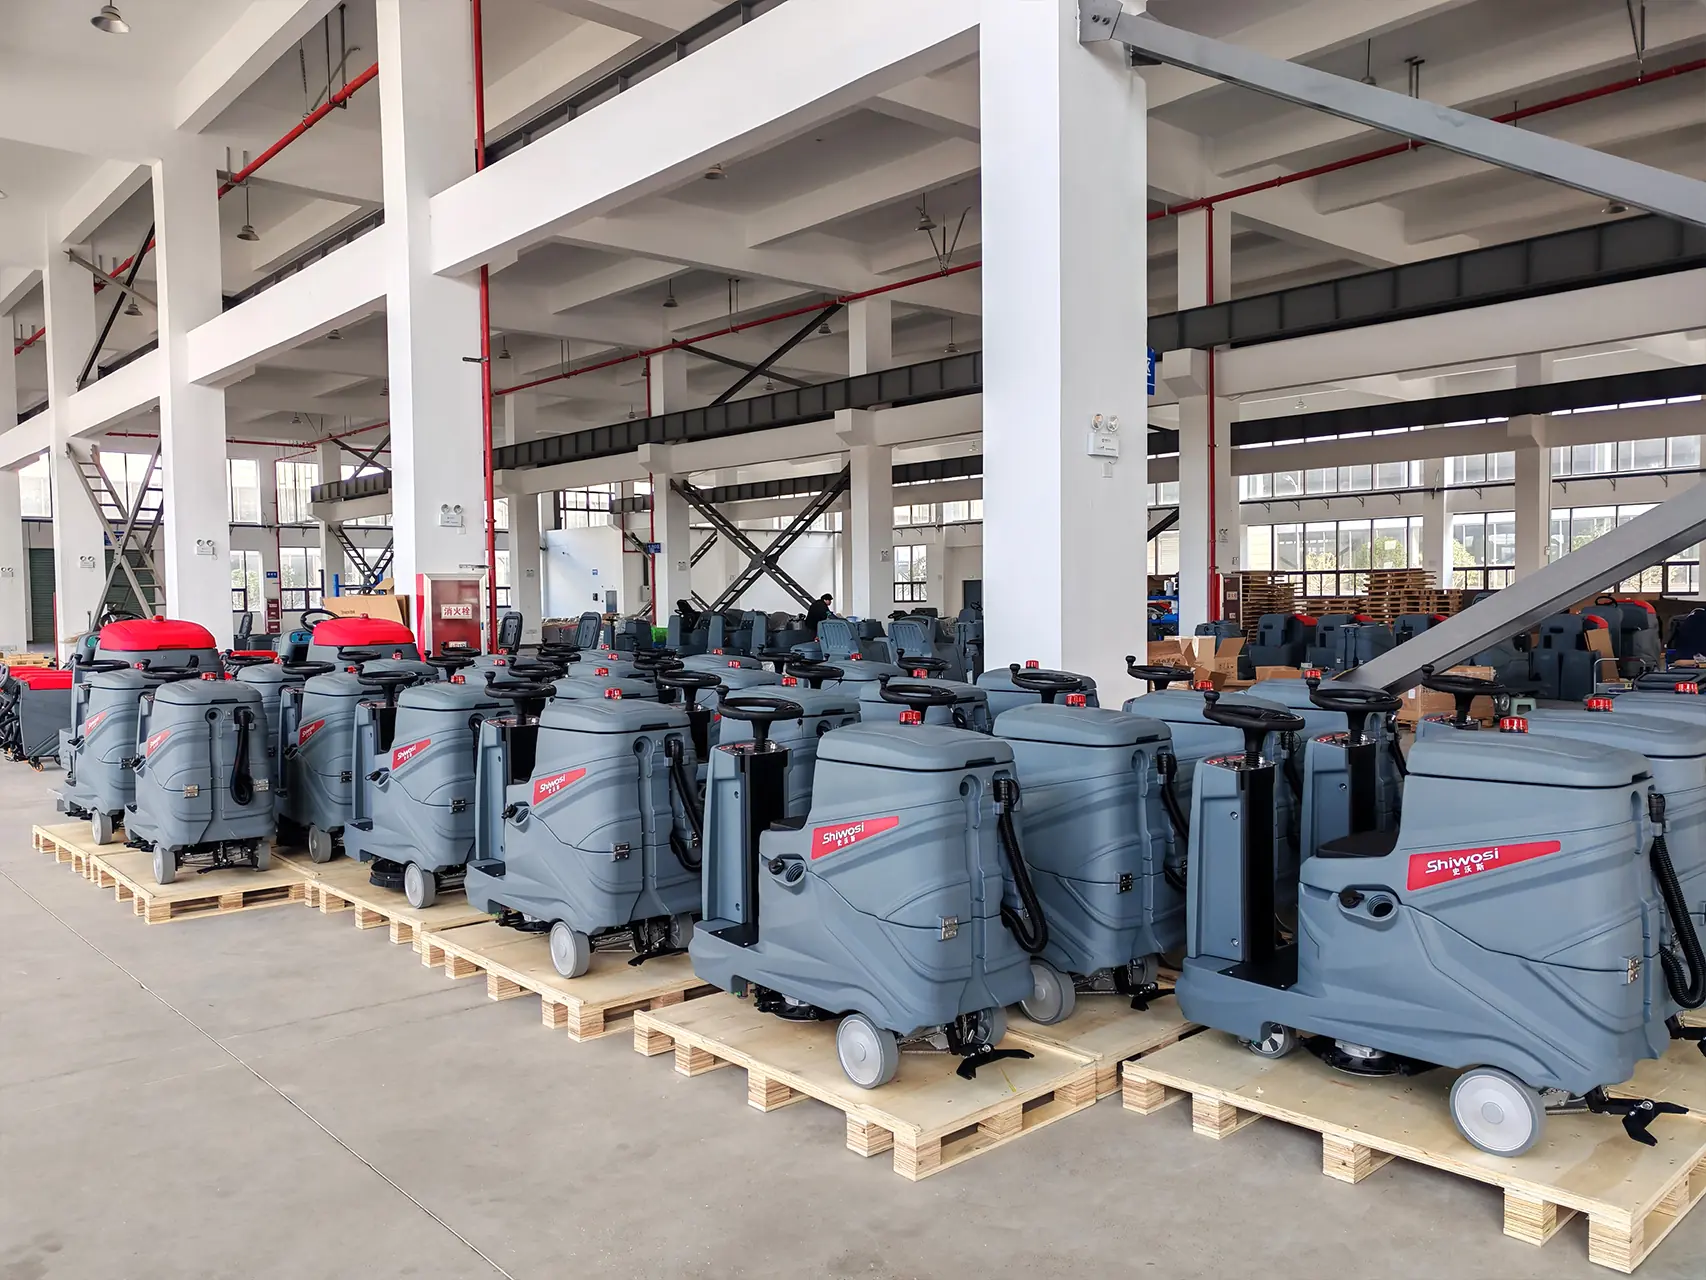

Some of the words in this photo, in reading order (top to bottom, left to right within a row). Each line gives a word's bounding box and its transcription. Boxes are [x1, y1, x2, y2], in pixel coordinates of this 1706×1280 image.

[443, 606, 470, 616] 消火栓
[539, 773, 566, 793] Shiwosi
[822, 822, 864, 845] Shiwosi
[1425, 847, 1499, 874] Shiwosi
[1452, 862, 1485, 876] 史沃斯
